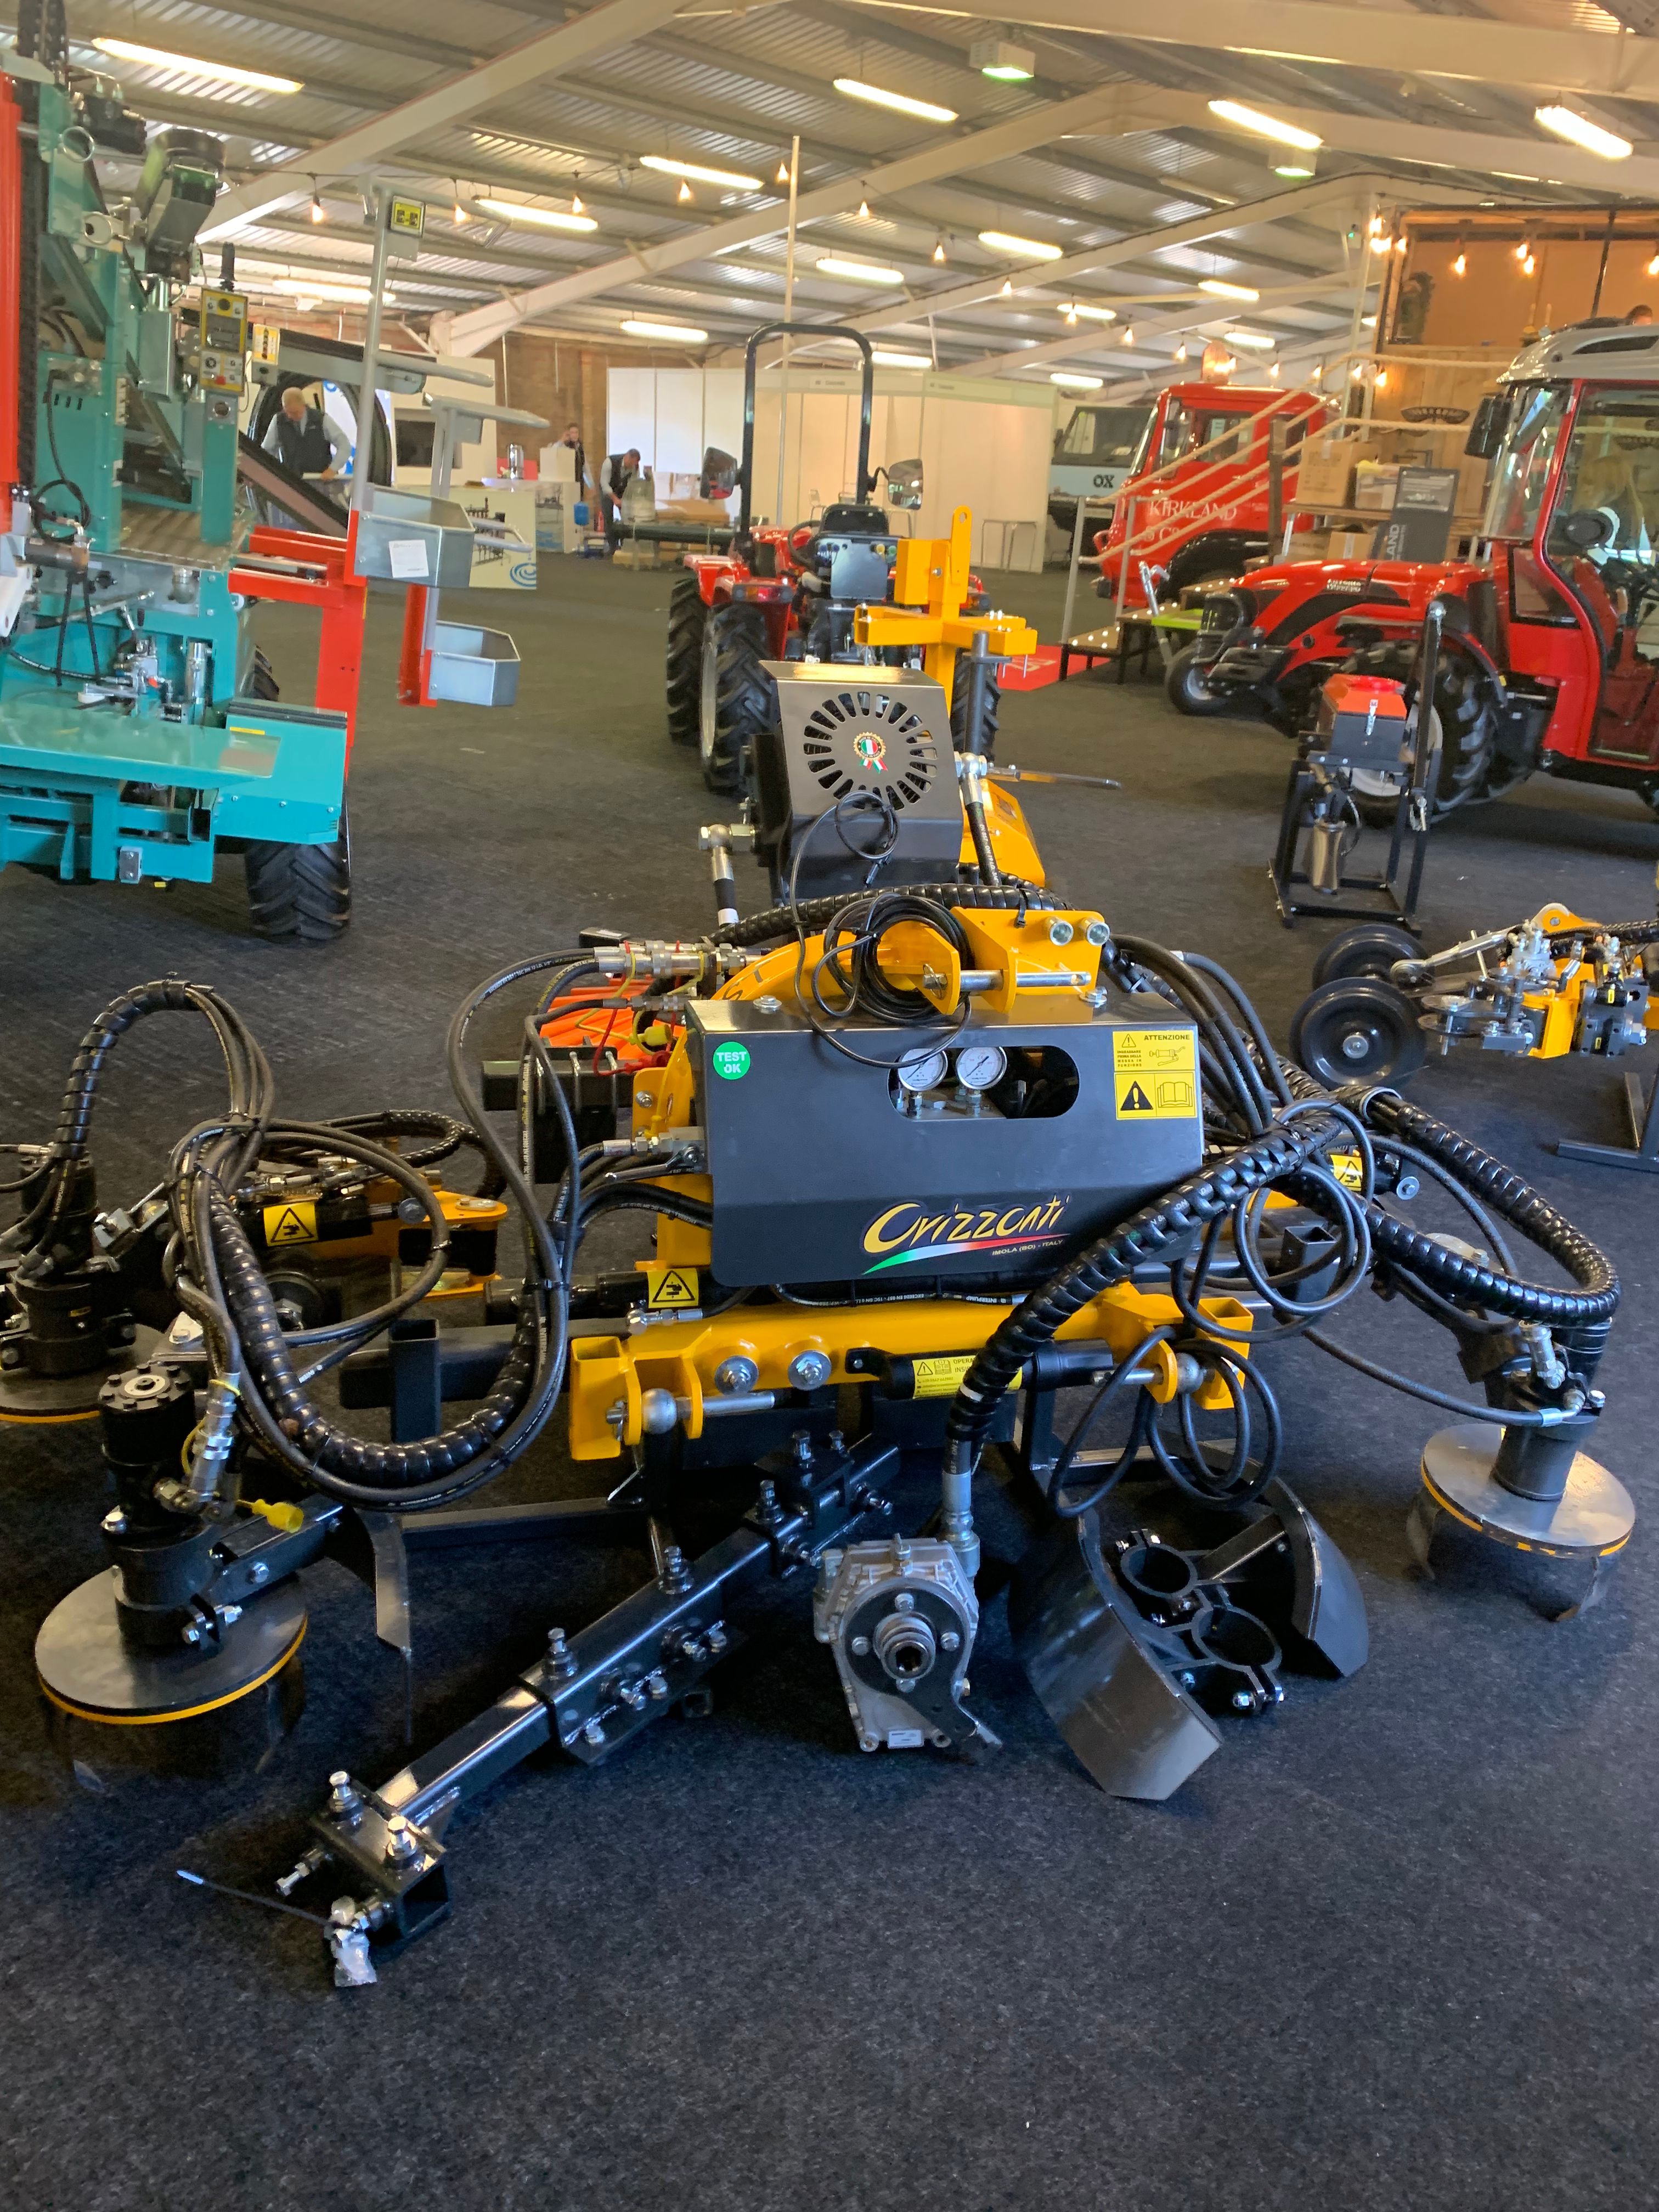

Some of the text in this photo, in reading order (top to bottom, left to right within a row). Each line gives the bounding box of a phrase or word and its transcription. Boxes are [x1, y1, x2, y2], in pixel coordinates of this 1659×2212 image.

[1093, 475, 1115, 488] OX
[716, 1051, 747, 1062] TEST
[724, 1063, 741, 1074] OK
[992, 1246, 1017, 1256] IMOLA
[1019, 1244, 1036, 1253] (BO)
[1042, 1239, 1063, 1248] ITALY
